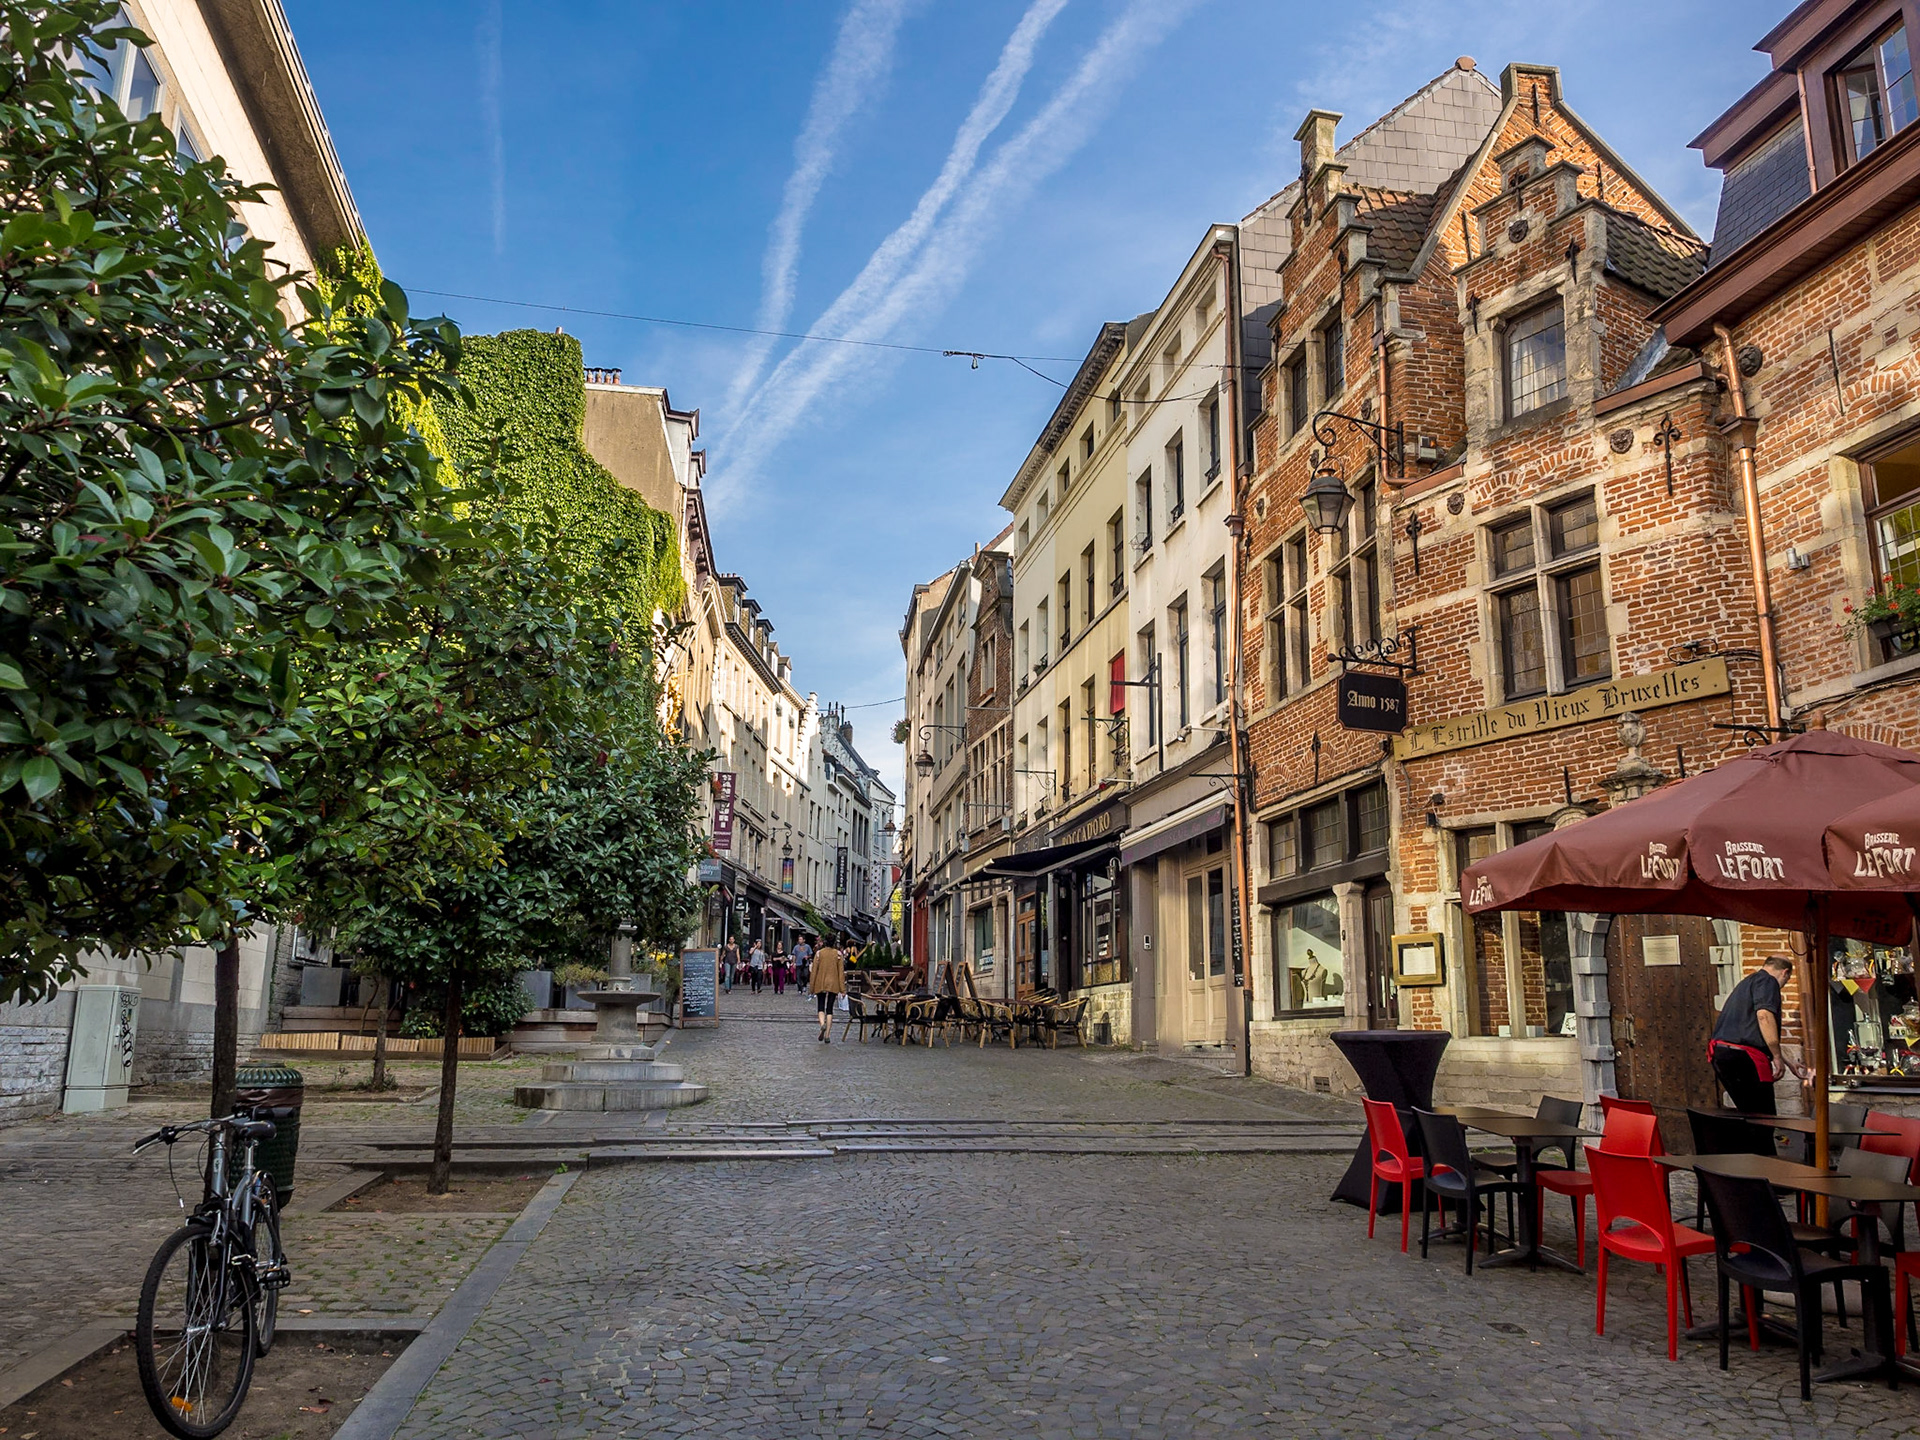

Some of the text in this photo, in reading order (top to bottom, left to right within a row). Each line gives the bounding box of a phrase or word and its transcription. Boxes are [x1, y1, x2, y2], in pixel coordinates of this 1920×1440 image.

[1347, 689, 1400, 714] Anno 1587
[1407, 671, 1700, 755] L'Estrille du Vieux Bruxelles
[1725, 841, 1766, 857] BRASSERIE
[1864, 832, 1900, 851] BRASSERIE
[1640, 853, 1681, 881] LEFORT
[1715, 853, 1786, 882] LEFORT
[1853, 846, 1917, 879] LEFORT
[1715, 947, 1725, 962] 7
